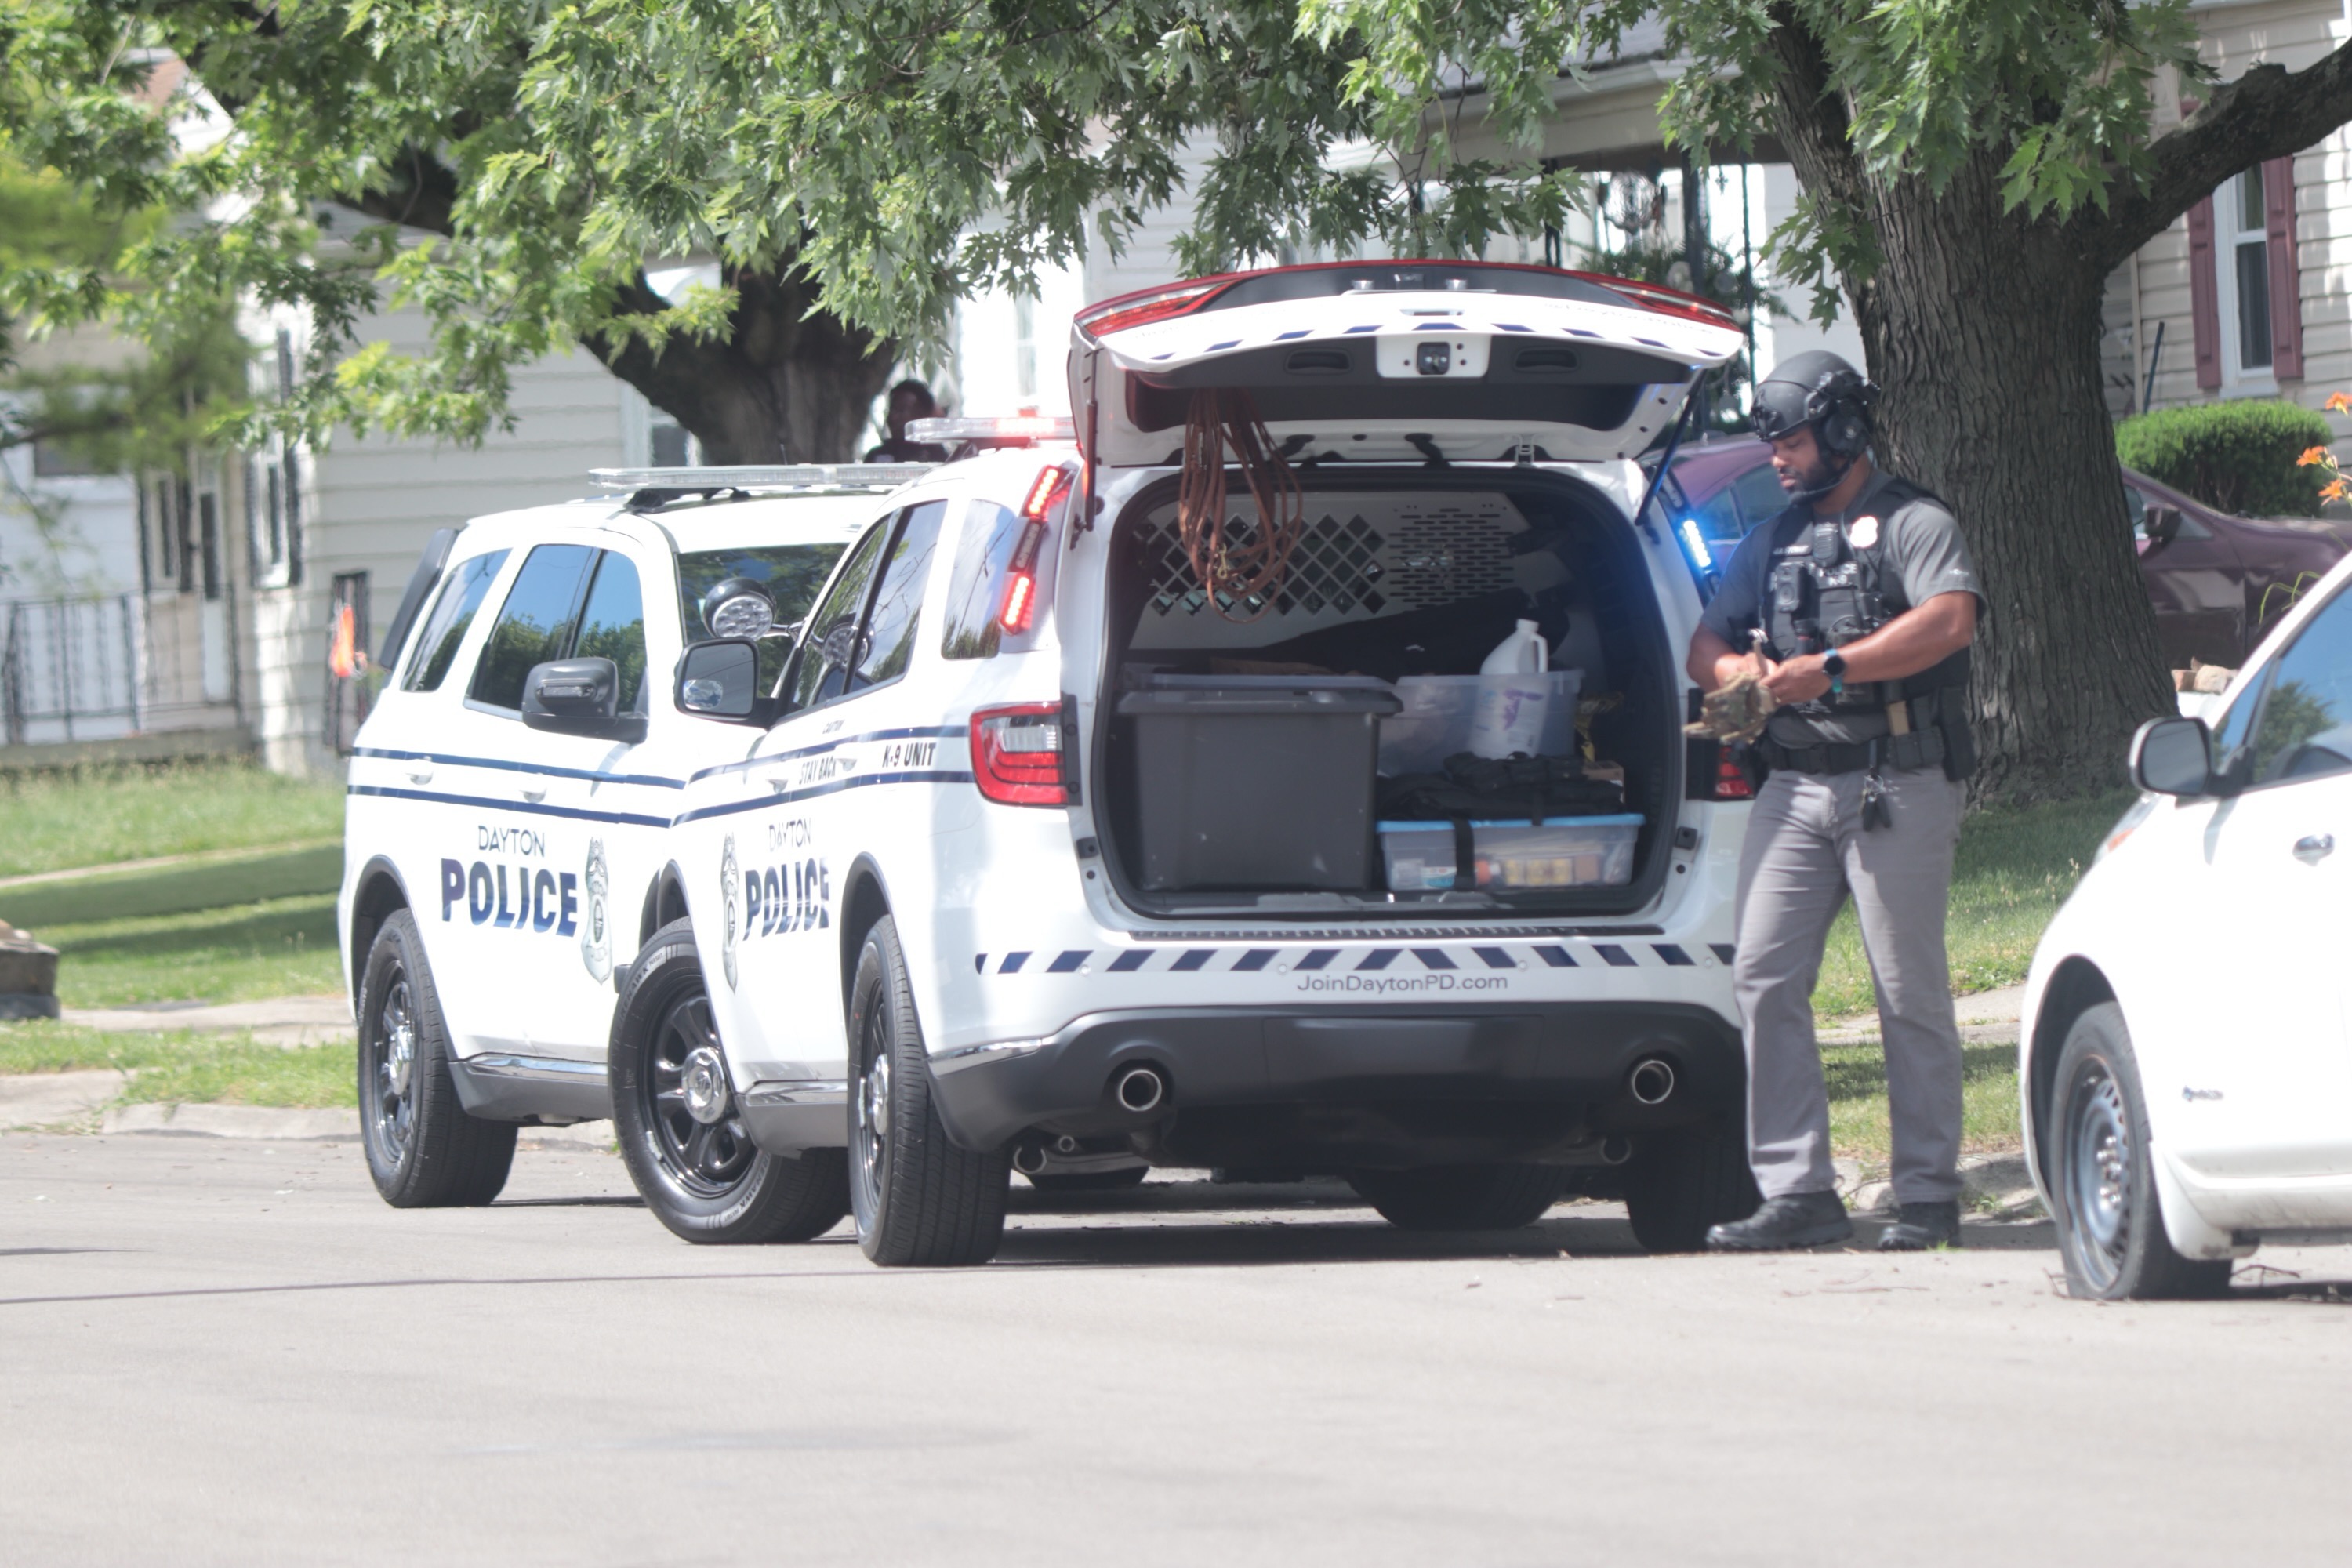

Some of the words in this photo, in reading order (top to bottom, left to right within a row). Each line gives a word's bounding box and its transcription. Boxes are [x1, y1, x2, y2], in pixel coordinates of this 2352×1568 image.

[798, 758, 818, 785] STAY
[818, 756, 837, 781] BACK
[882, 744, 902, 768] K-9
[903, 742, 937, 767] UNIT
[477, 825, 545, 858] DAYTON
[768, 818, 811, 852] DAYTON
[441, 858, 578, 938] POLICE
[742, 857, 829, 941] POLICE
[1297, 974, 1508, 995] JoinDaytonPD.com
